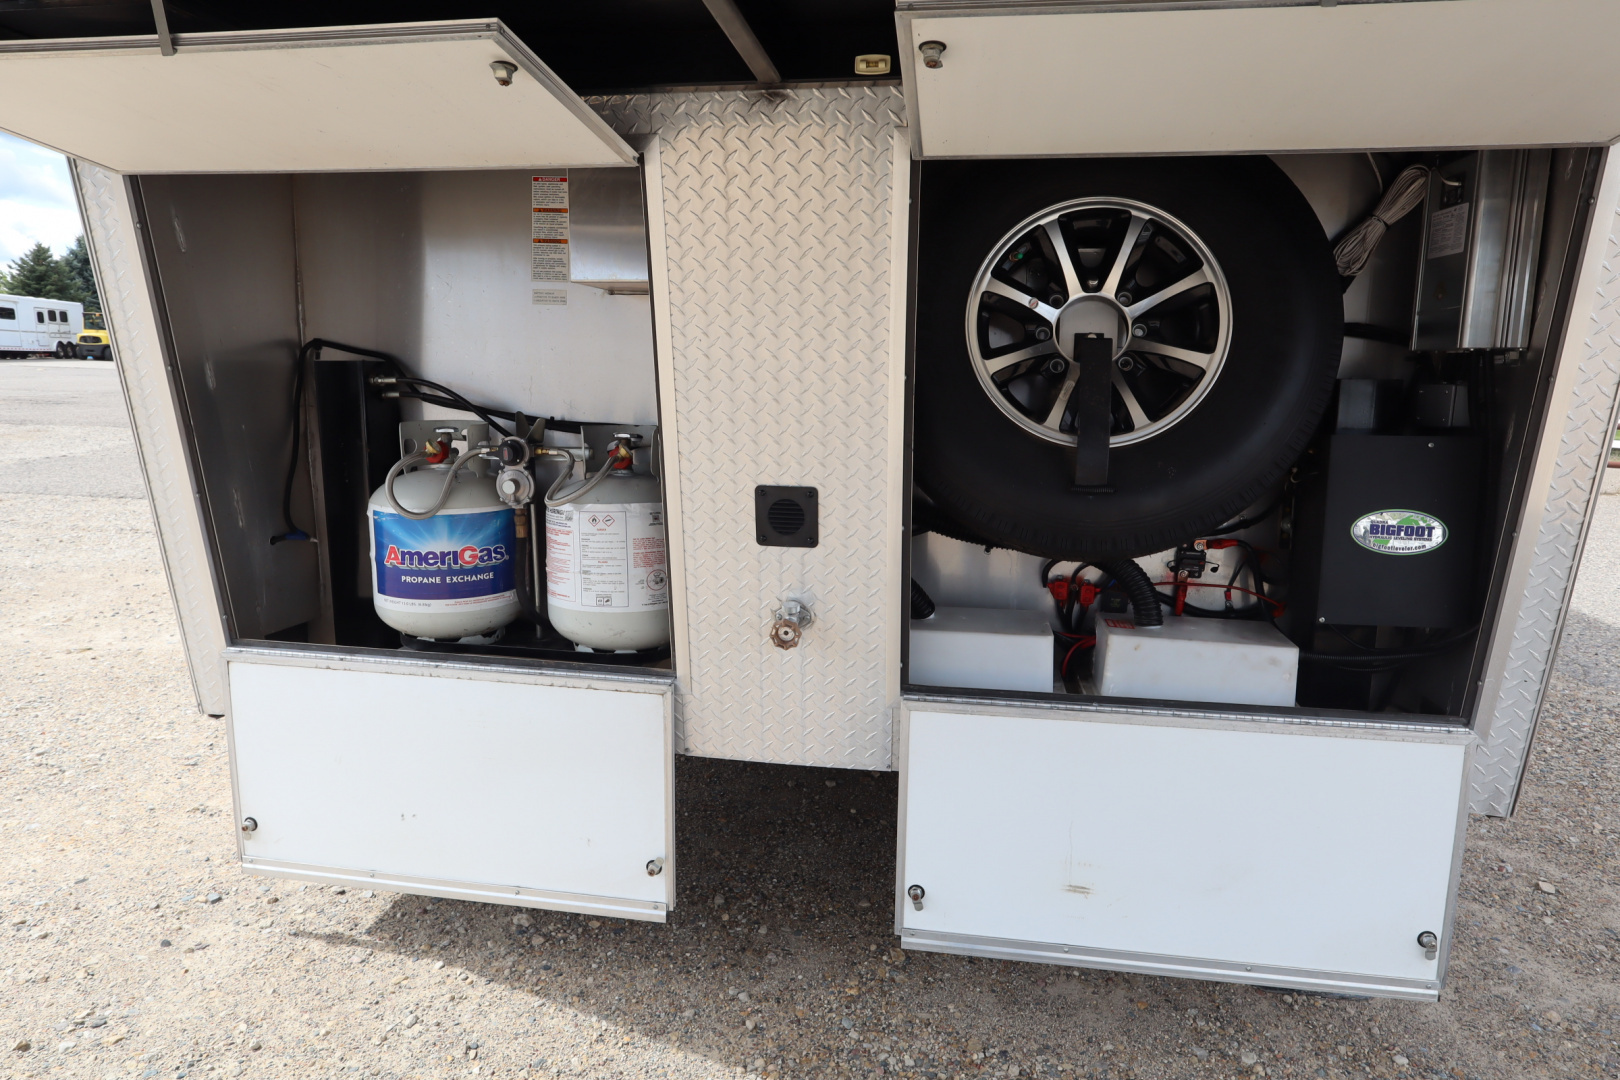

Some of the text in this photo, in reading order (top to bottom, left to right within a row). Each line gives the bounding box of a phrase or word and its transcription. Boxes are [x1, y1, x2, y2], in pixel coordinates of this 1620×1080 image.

[1370, 524, 1435, 537] BIGFOOT
[384, 543, 507, 570] AmeriGas
[401, 571, 494, 584] PROPANE EXCHANGE
